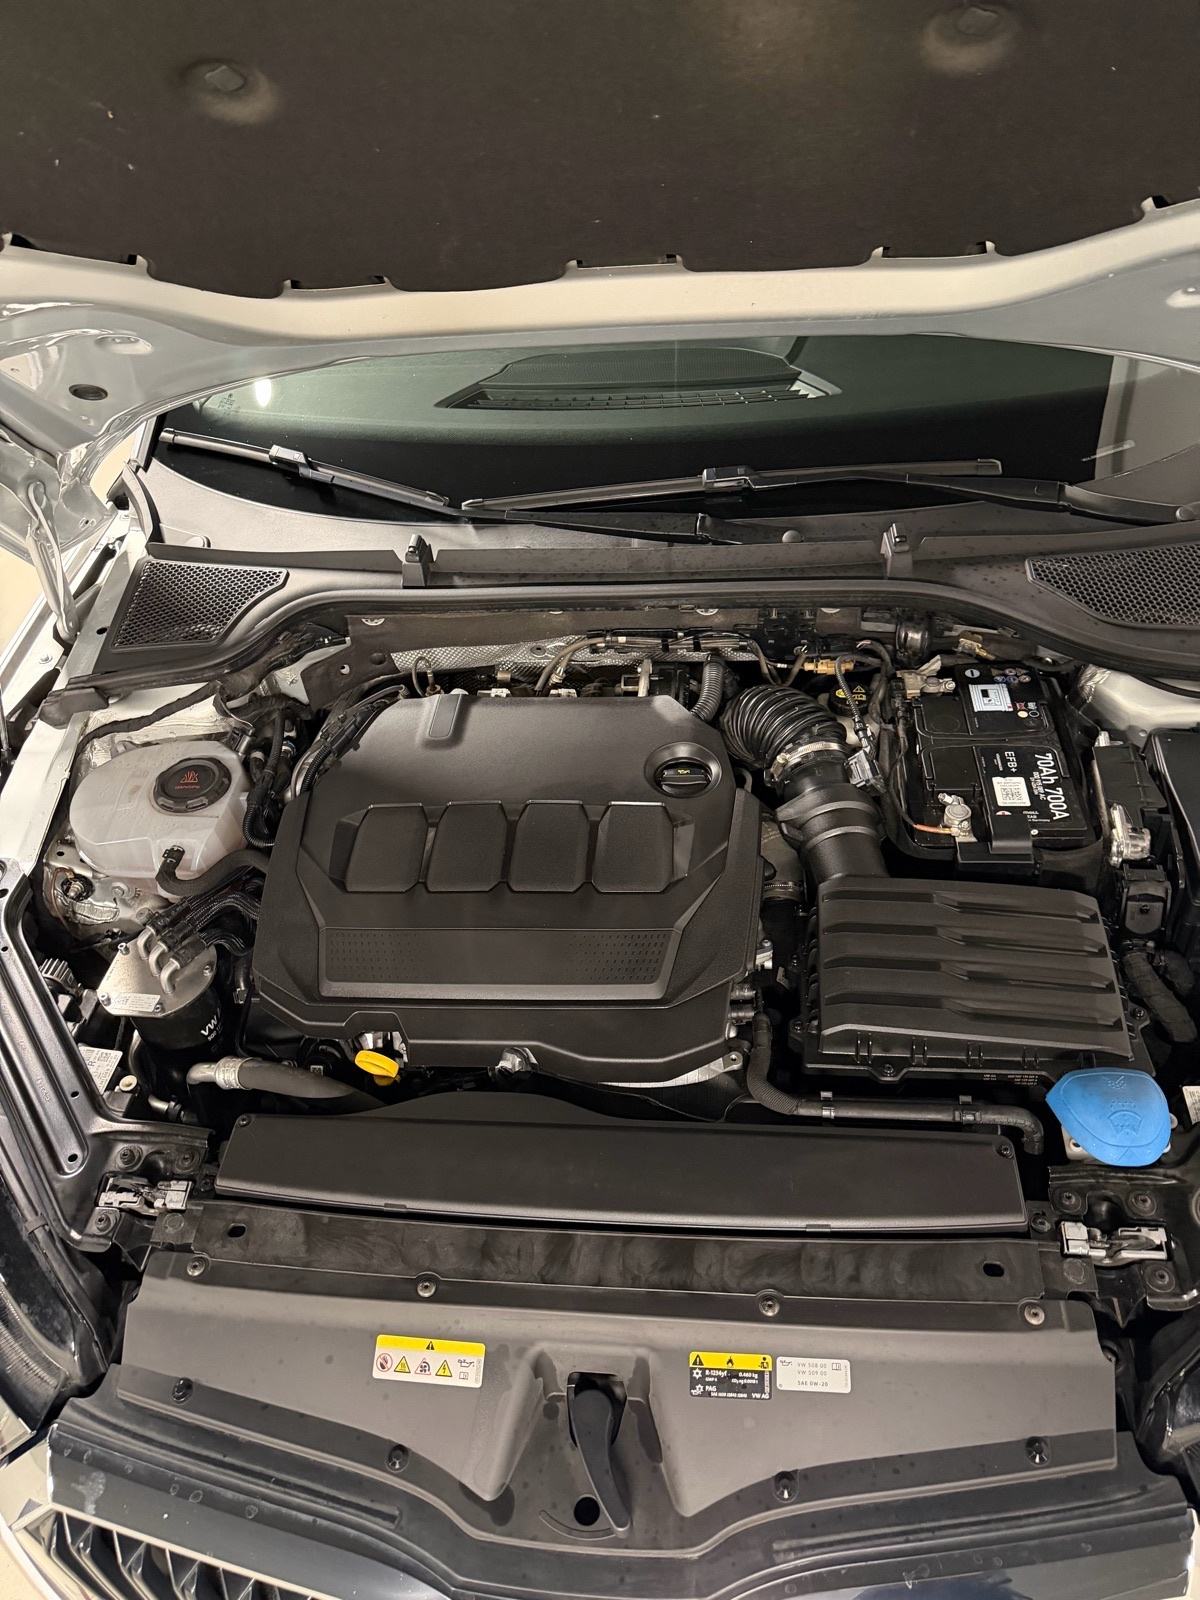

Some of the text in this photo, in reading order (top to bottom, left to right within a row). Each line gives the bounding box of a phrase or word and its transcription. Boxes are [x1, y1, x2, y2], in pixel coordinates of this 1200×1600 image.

[1004, 751, 1017, 773] EFB+
[1035, 753, 1070, 820] 70Ah 700A
[200, 1015, 217, 1036] VW
